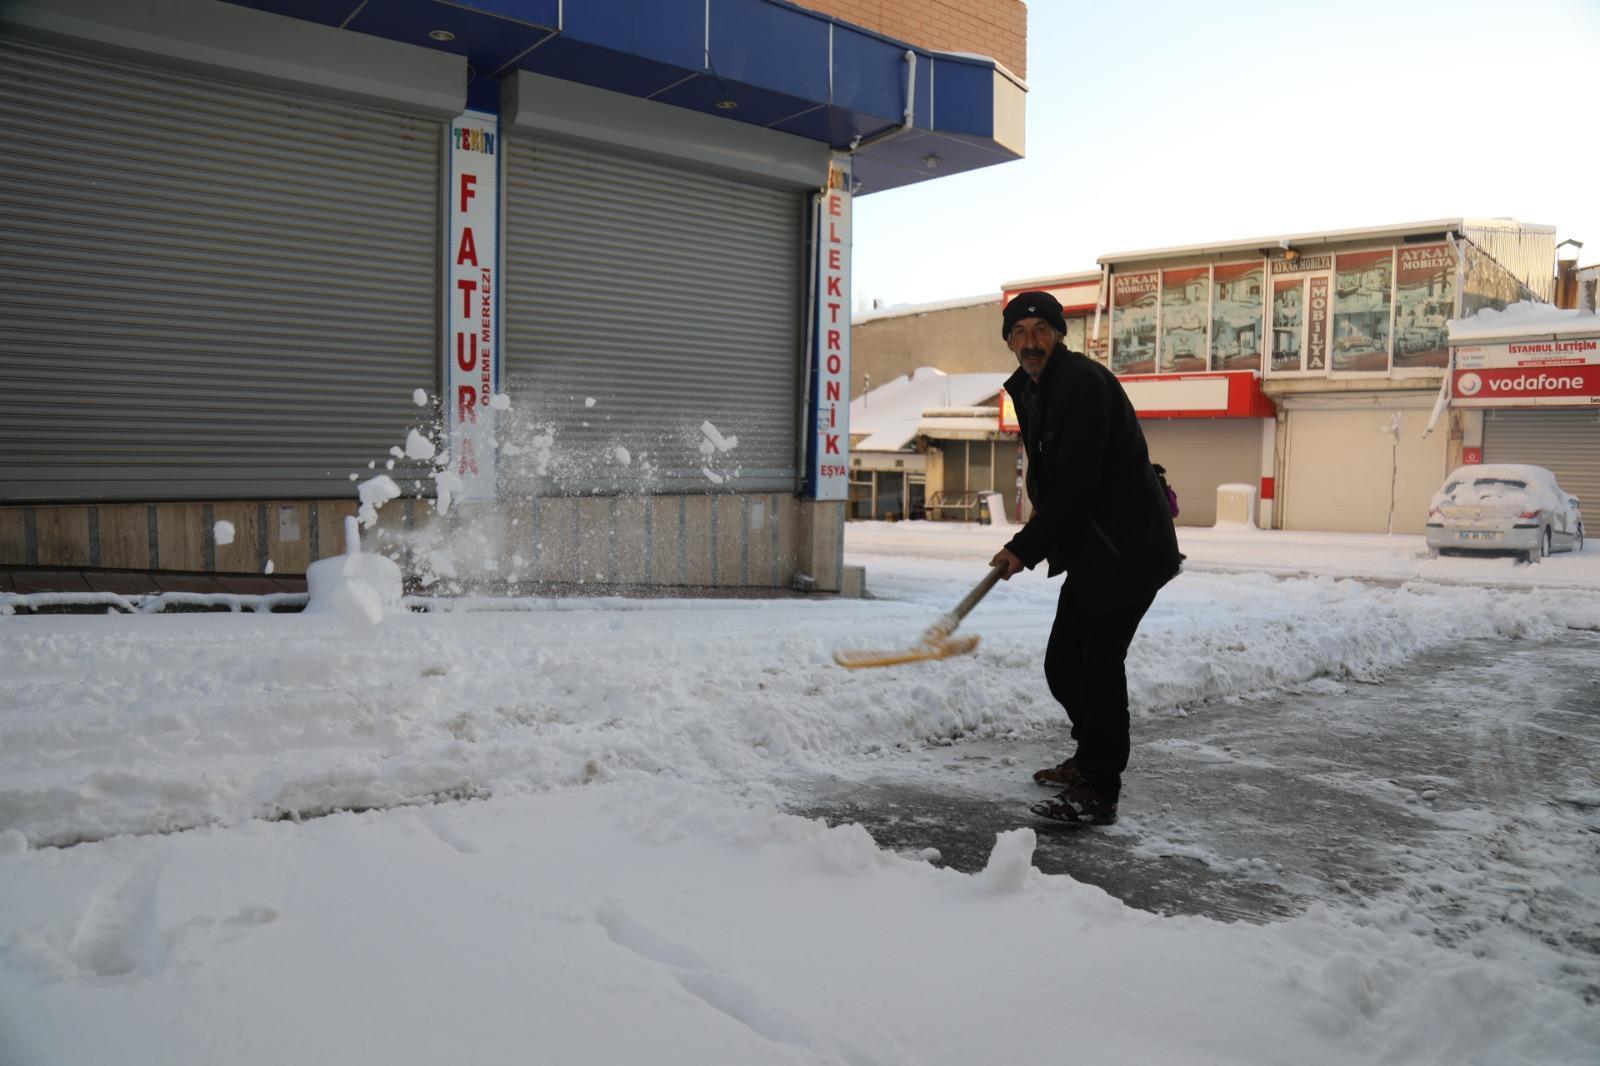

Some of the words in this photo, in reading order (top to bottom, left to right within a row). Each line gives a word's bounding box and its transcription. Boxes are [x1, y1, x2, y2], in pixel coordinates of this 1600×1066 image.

[454, 127, 495, 155] TEKİN
[1401, 247, 1454, 261] AYKAR
[1115, 273, 1158, 288] AYKAR
[480, 267, 491, 342] MERKEZİ
[456, 173, 479, 478] FATURA
[825, 194, 842, 455] ELEKTRONİK
[1508, 343, 1553, 354] İSTANBUL
[1554, 340, 1597, 352] İLETİŞİM
[480, 346, 491, 407] ÖDEME
[1488, 373, 1584, 391] vodafone
[820, 465, 846, 478] EŞYA
